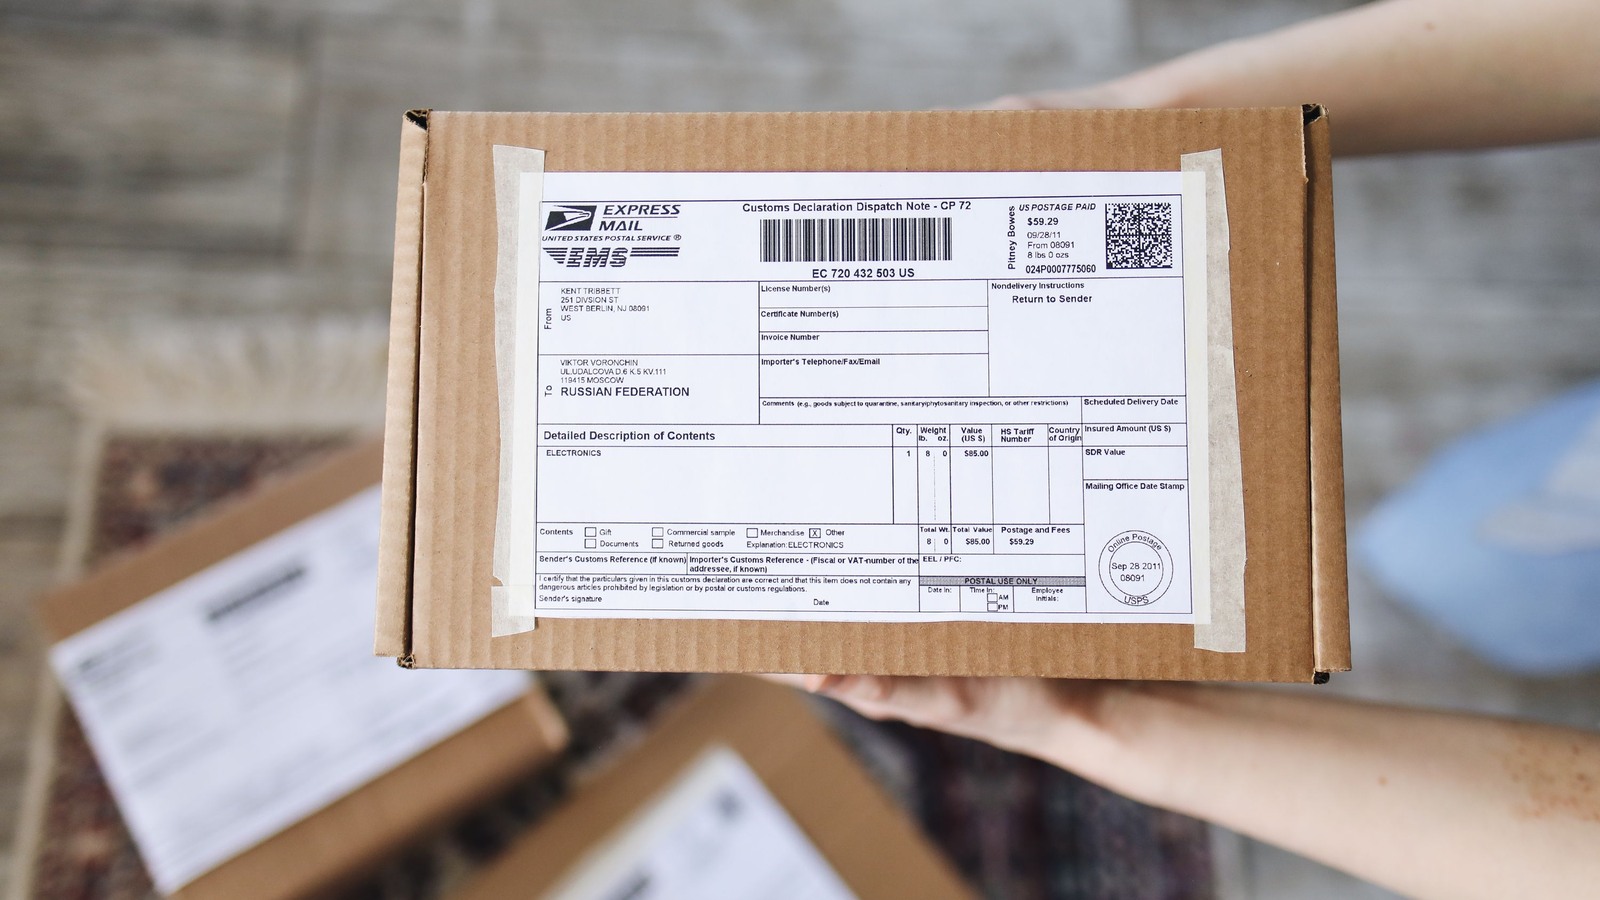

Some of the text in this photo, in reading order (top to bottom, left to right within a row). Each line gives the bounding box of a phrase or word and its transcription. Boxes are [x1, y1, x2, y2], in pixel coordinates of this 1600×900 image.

[602, 205, 681, 215] EXPRESS
[742, 201, 971, 212] Customs Declaration Dispatch Note CP 72
[1031, 203, 1074, 211] POSTAGE
[599, 220, 643, 231] MAIL
[1027, 217, 1059, 226] $59.29
[1007, 206, 1018, 269] Pitney Bowes
[1027, 241, 1048, 249] From
[566, 247, 629, 268] EMS
[812, 268, 915, 278] EC 720 432 503 US
[1025, 264, 1097, 274] 024P0007775060
[791, 285, 831, 293] Number(s)
[1046, 295, 1056, 303] to
[1059, 295, 1093, 303] Sender
[543, 308, 552, 329] From
[799, 310, 839, 318] Number(s)
[801, 358, 881, 366] Telephone/Fax/Email
[544, 385, 553, 396] To
[560, 387, 690, 396] RUSSIAN FEDERATION
[1127, 398, 1158, 406] Delivery
[896, 427, 912, 436] Qty.
[920, 427, 947, 435] Weight
[1048, 426, 1081, 435] Country
[543, 431, 716, 442] Detailed Description of Contents
[1048, 434, 1082, 444] of Origin
[1085, 483, 1114, 491] Mailing
[1159, 483, 1185, 491] Stamp
[710, 529, 736, 537] sample
[1001, 526, 1033, 535] Postage
[1107, 533, 1163, 553] Online Postage
[658, 556, 687, 565] known)
[689, 556, 729, 564] Importer's
[810, 557, 836, 565] (Fiscal
[906, 556, 919, 565] the
[1111, 562, 1127, 571] Sep
[964, 577, 1038, 585] POSTAL USE ONLY
[1123, 595, 1150, 605] USPS
